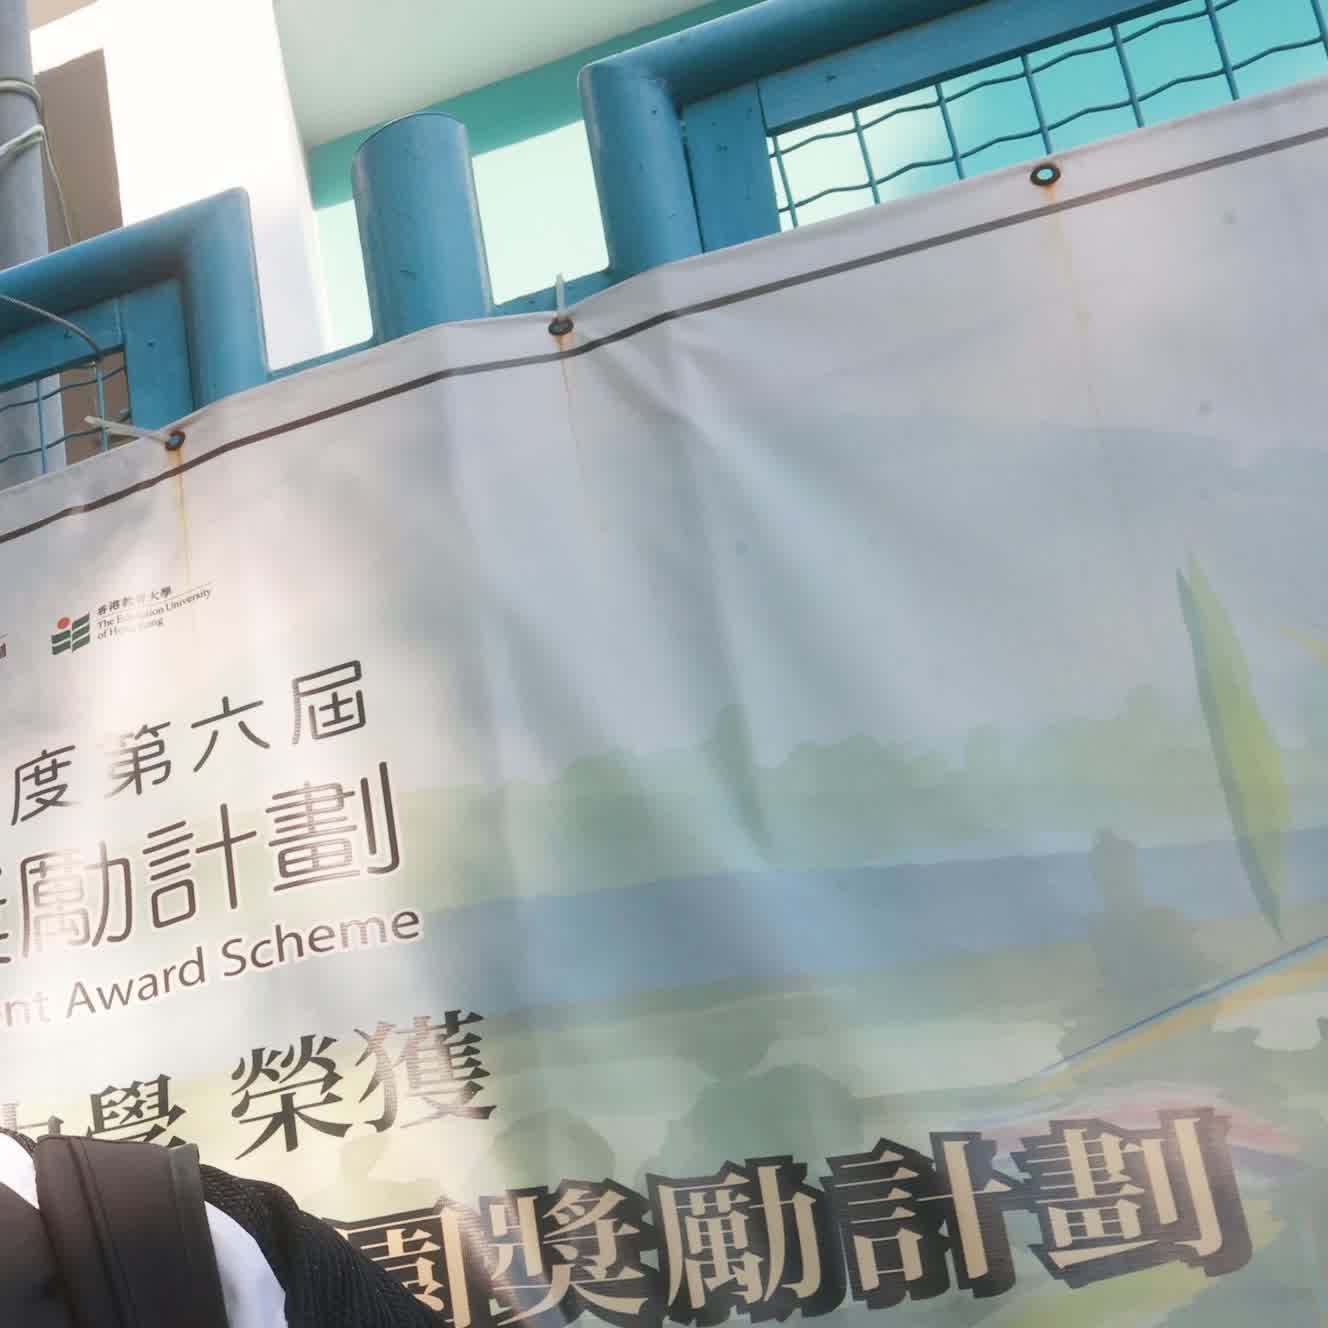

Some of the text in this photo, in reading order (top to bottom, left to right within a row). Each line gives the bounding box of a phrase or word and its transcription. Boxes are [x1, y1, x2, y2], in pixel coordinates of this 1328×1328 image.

[64, 945, 207, 1022] Award
[220, 905, 423, 980] Scheme
[228, 1008, 497, 1160] 榮獲
